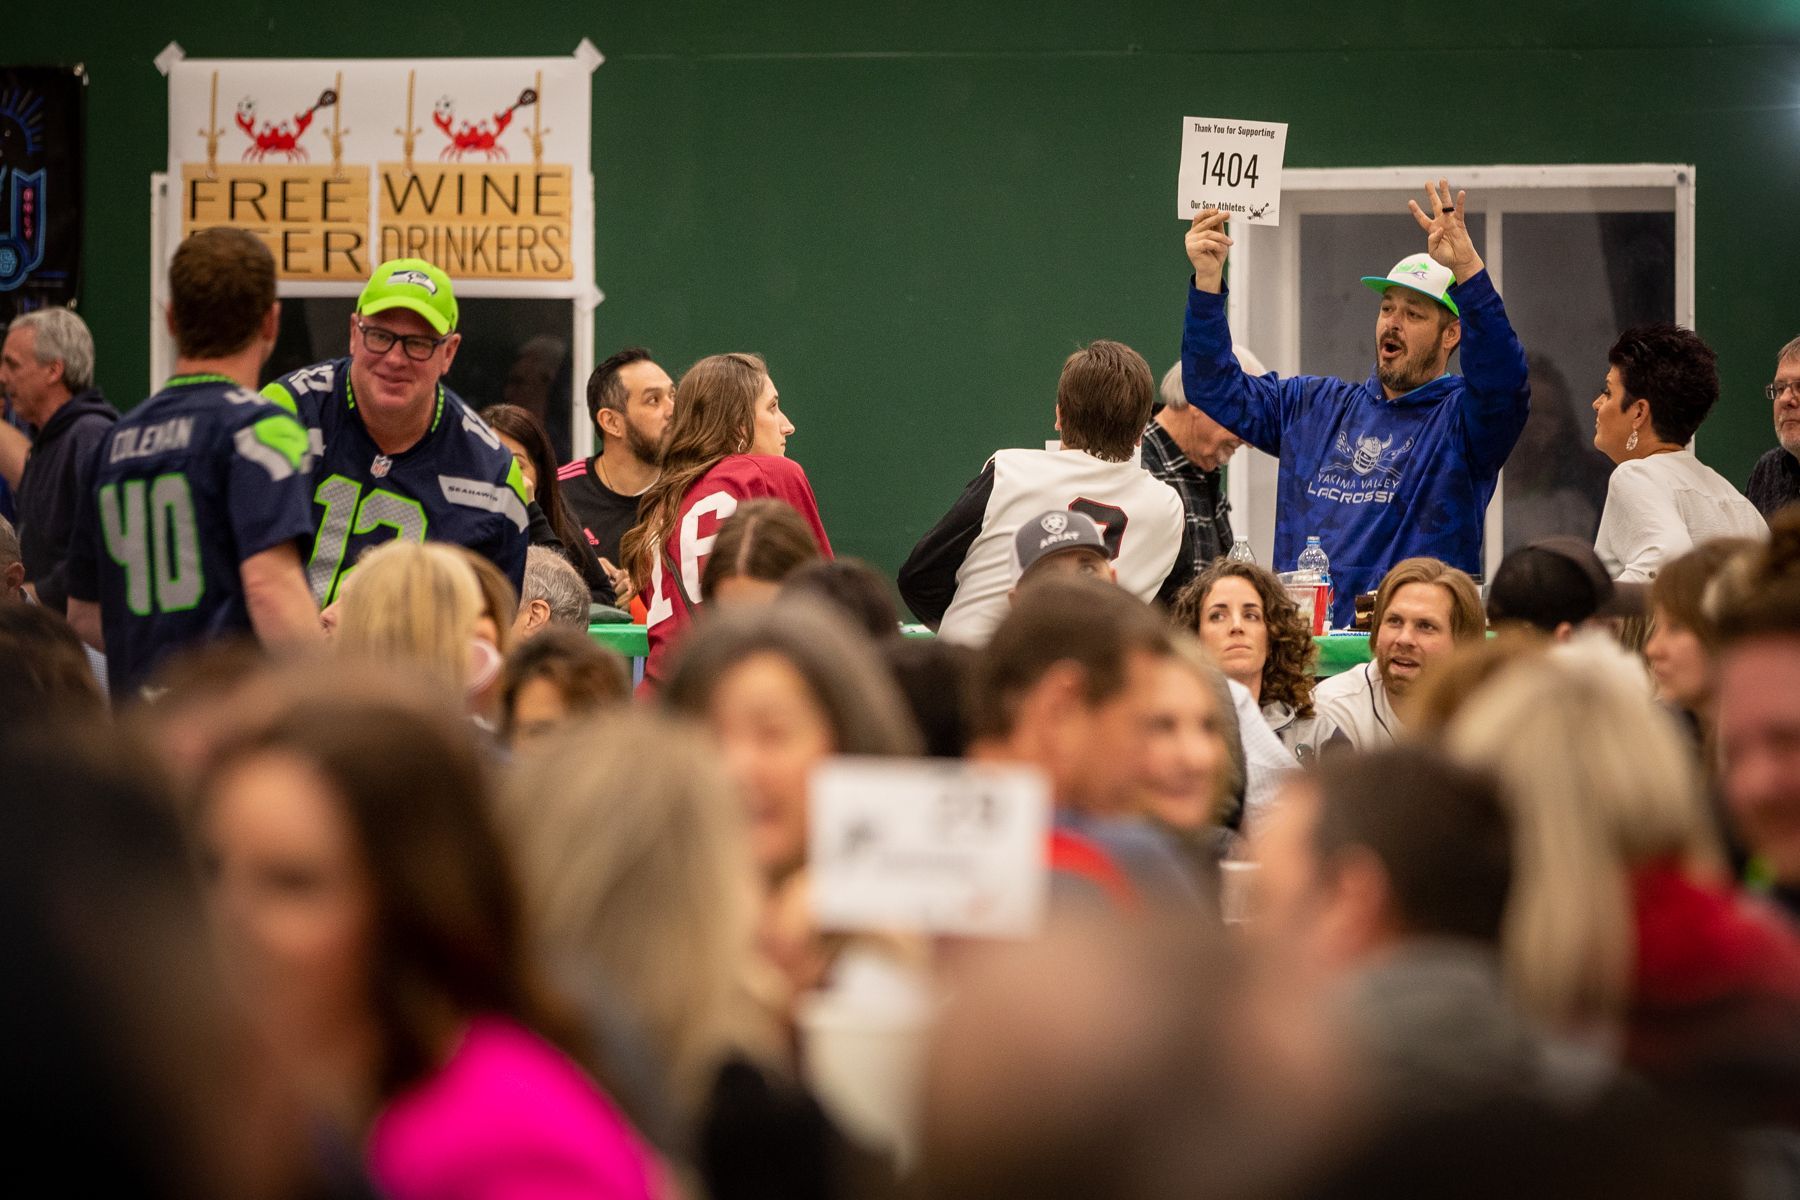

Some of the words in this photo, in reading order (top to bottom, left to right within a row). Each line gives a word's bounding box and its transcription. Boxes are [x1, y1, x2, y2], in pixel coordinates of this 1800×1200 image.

[1194, 123, 1212, 133] Thank
[1213, 124, 1225, 134] You
[1226, 125, 1236, 134] for
[1237, 126, 1275, 139] Supporting
[1201, 151, 1259, 188] 1404
[190, 178, 351, 222] FREE
[384, 172, 562, 217] WINE
[1190, 200, 1201, 209] Our
[1217, 202, 1246, 212] Athletes
[190, 229, 363, 274] ER
[381, 224, 565, 274] DRINKERS
[1317, 473, 1356, 489] YAKIMA
[1361, 479, 1400, 489] VALLEY
[99, 472, 206, 616] 40
[305, 473, 428, 612] 12
